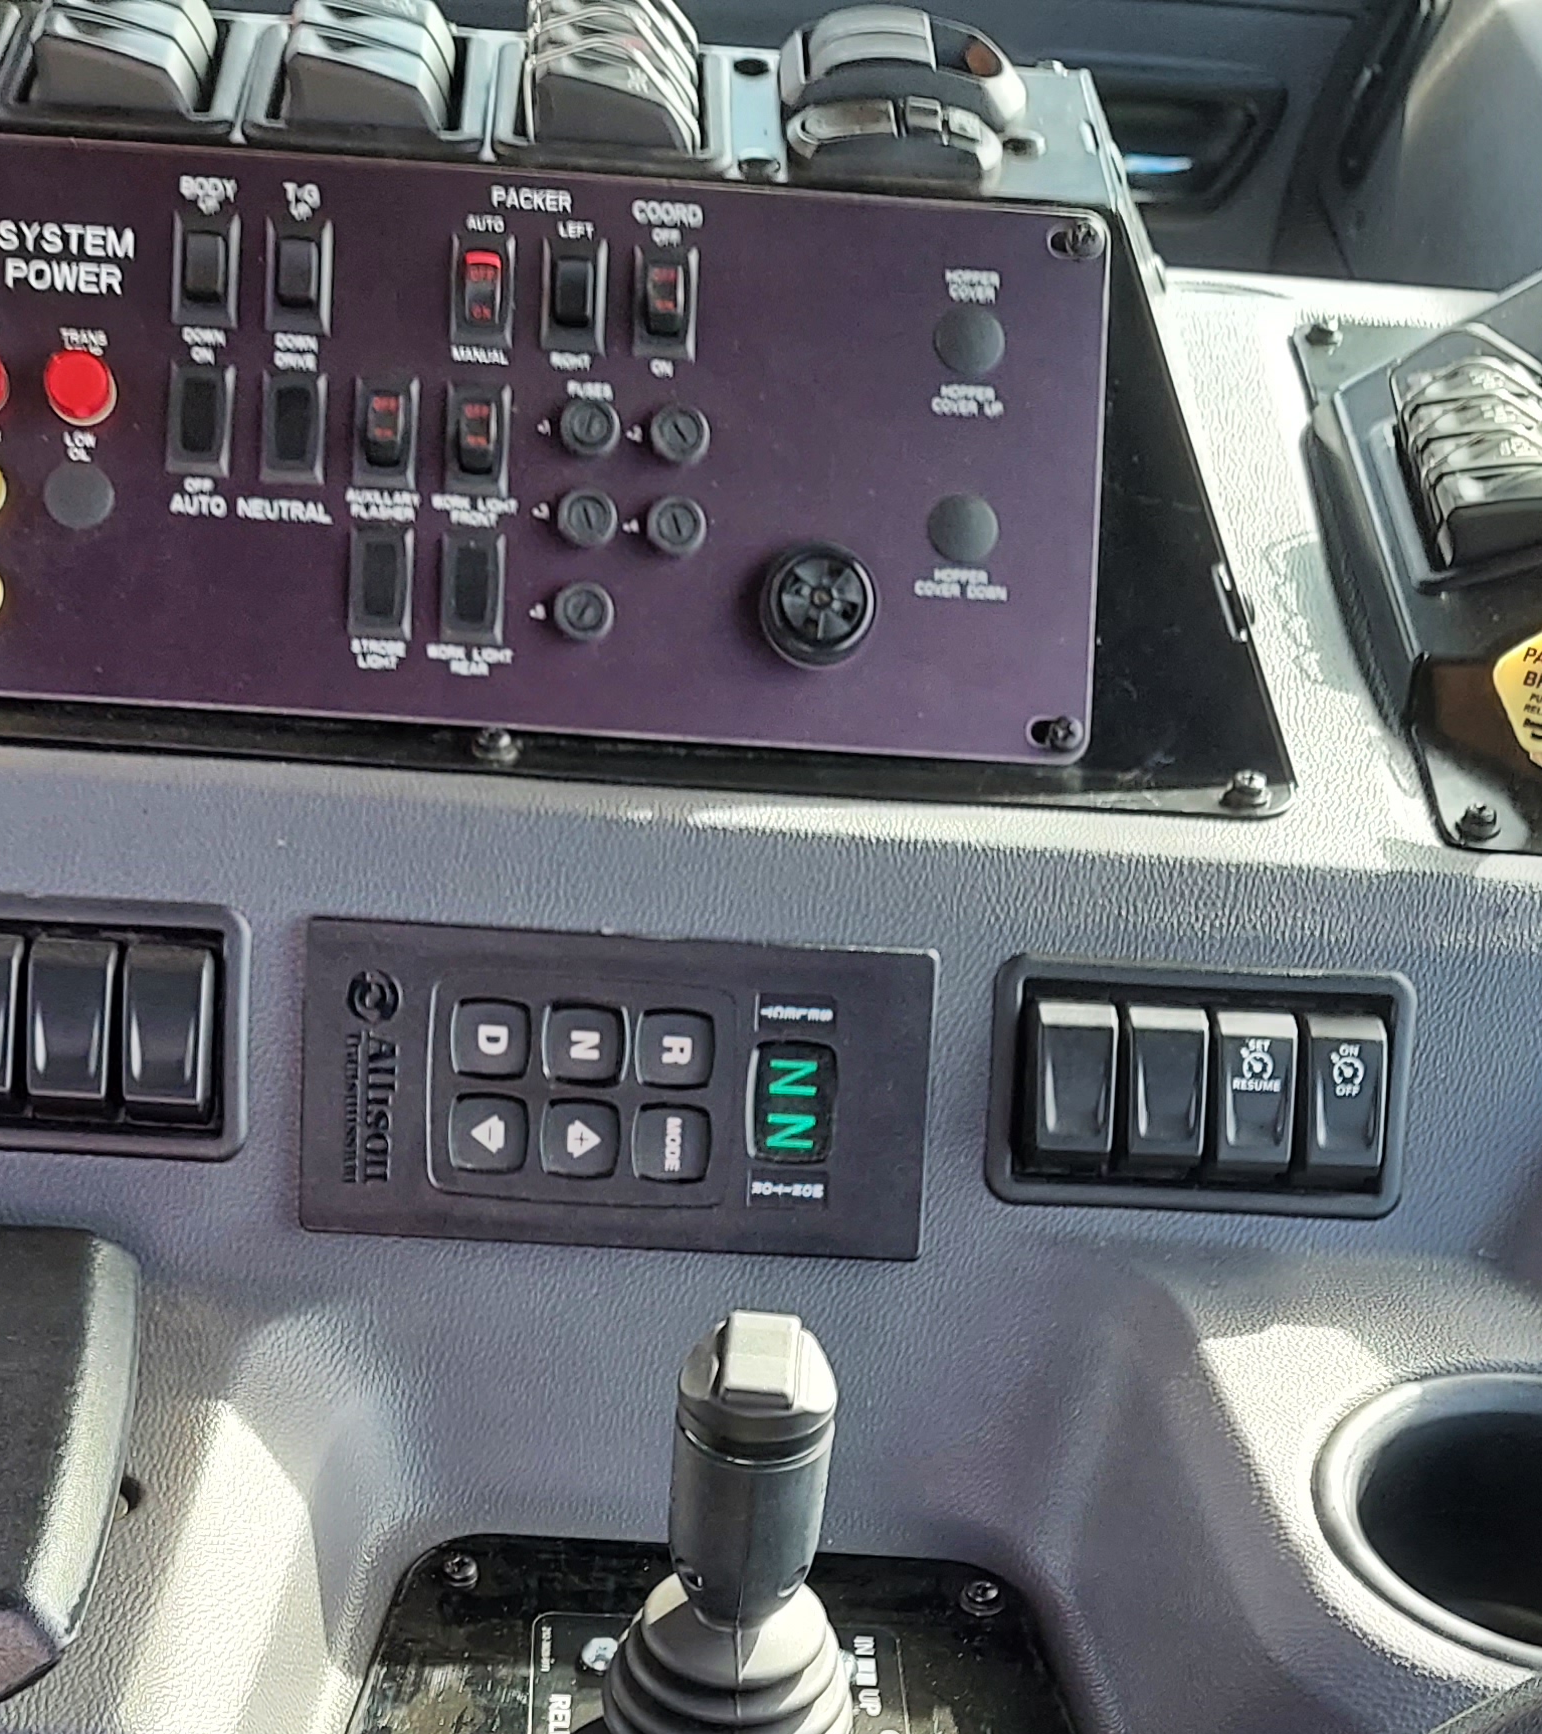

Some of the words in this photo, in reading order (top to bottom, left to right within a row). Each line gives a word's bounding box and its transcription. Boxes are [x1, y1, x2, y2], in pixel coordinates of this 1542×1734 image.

[179, 174, 237, 203] BODY
[491, 184, 573, 214] PACKER
[466, 213, 505, 234] AUTO
[631, 198, 704, 228] COORD
[557, 220, 595, 241] LEFT
[4, 256, 123, 296] POWER
[59, 327, 109, 346] TRANS
[181, 326, 227, 347] DOWN
[274, 331, 319, 353] DOWN
[450, 344, 509, 367] MANUAL
[649, 358, 675, 379] ON
[63, 430, 97, 449] LOW
[169, 493, 227, 517] AUTO
[236, 496, 334, 525] NEUTRAL
[478, 1024, 508, 1056] D
[569, 1029, 600, 1060] N
[662, 1036, 693, 1065] R
[1247, 1038, 1271, 1052] SET
[1339, 1043, 1360, 1057] ON
[1232, 1077, 1281, 1093] RESUME
[1335, 1084, 1360, 1097] OFF
[363, 1030, 400, 1185] Allison
[665, 1116, 683, 1172] MODE
[859, 1688, 882, 1717] UP
